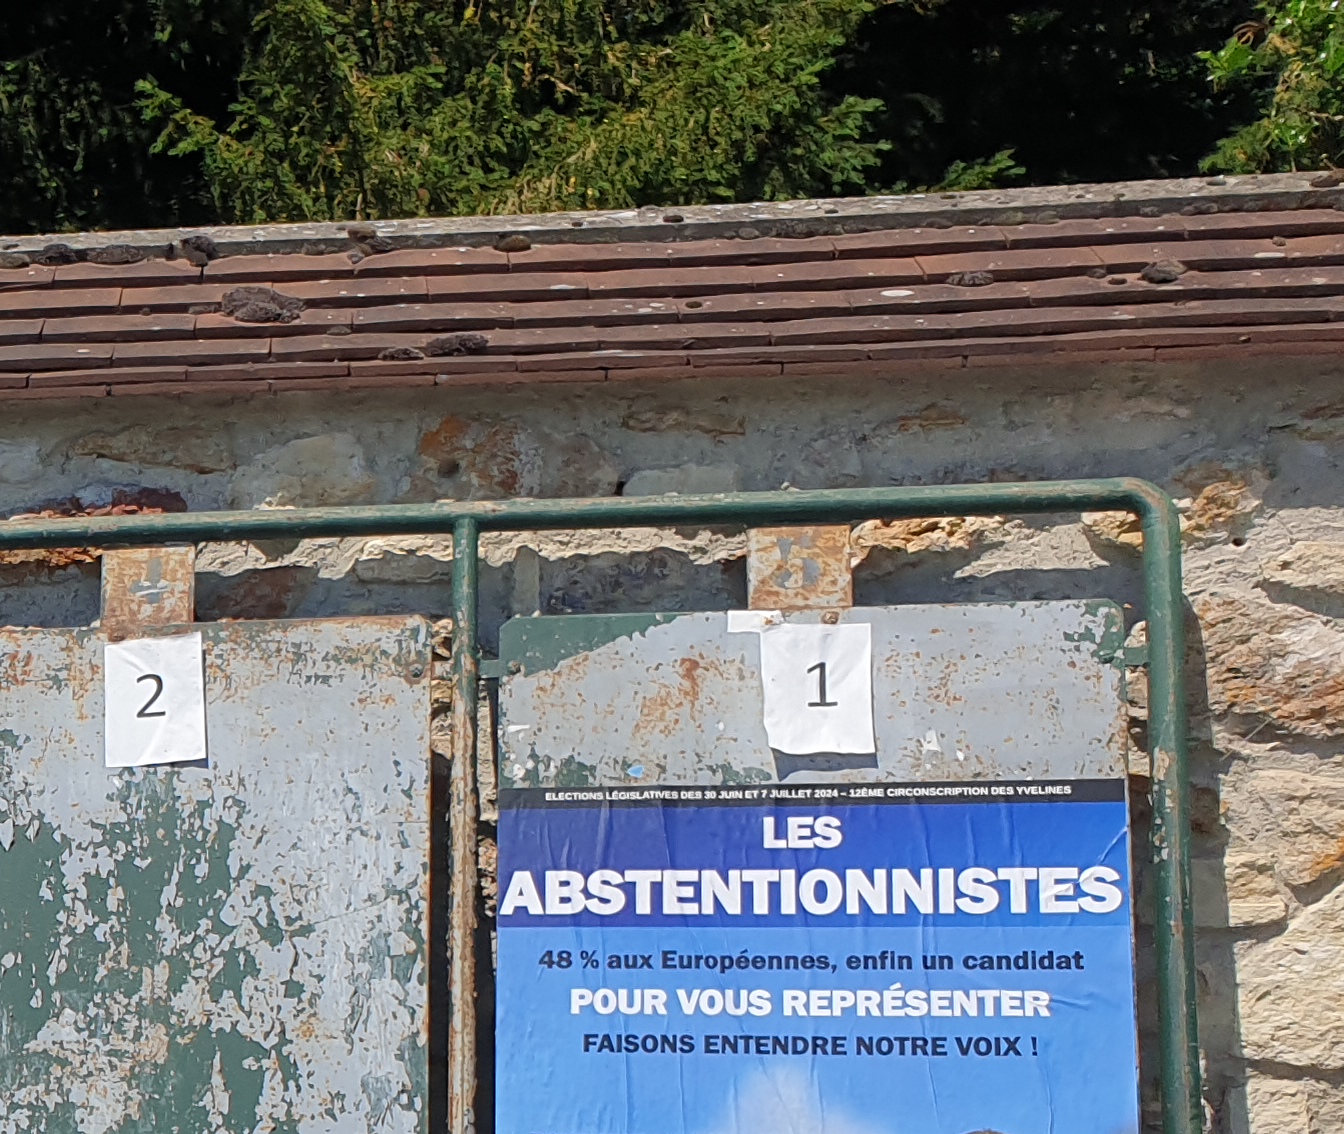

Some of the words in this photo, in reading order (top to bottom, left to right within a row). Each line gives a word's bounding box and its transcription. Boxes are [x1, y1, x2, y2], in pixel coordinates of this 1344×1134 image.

[137, 673, 166, 718] 2
[807, 662, 838, 707] 1
[606, 790, 678, 800] LÉGISLATIVES
[681, 790, 702, 799] DES
[770, 789, 811, 798] JUILLET
[814, 789, 838, 798] 2024
[887, 786, 988, 797] CIRCONSCRIPTION
[991, 786, 1014, 796] DES
[1016, 785, 1072, 795] YVELINES
[762, 815, 843, 849] LES
[499, 865, 1123, 916] ABSTENTIONNISTES
[539, 950, 572, 969] 48
[580, 950, 599, 969] %
[607, 954, 654, 970] aux
[662, 949, 837, 973] Européennes,
[846, 950, 913, 970] enfin
[923, 954, 953, 970] un
[963, 950, 1085, 970] candidat
[570, 988, 667, 1015] POUR
[677, 989, 772, 1016] VOUS
[783, 982, 1051, 1017] REPRÉSENTER
[583, 1034, 695, 1054] FAISONS
[704, 1035, 847, 1055] ENTENDRE
[856, 1036, 948, 1056] NOTRE
[955, 1036, 1022, 1057] VOIX
